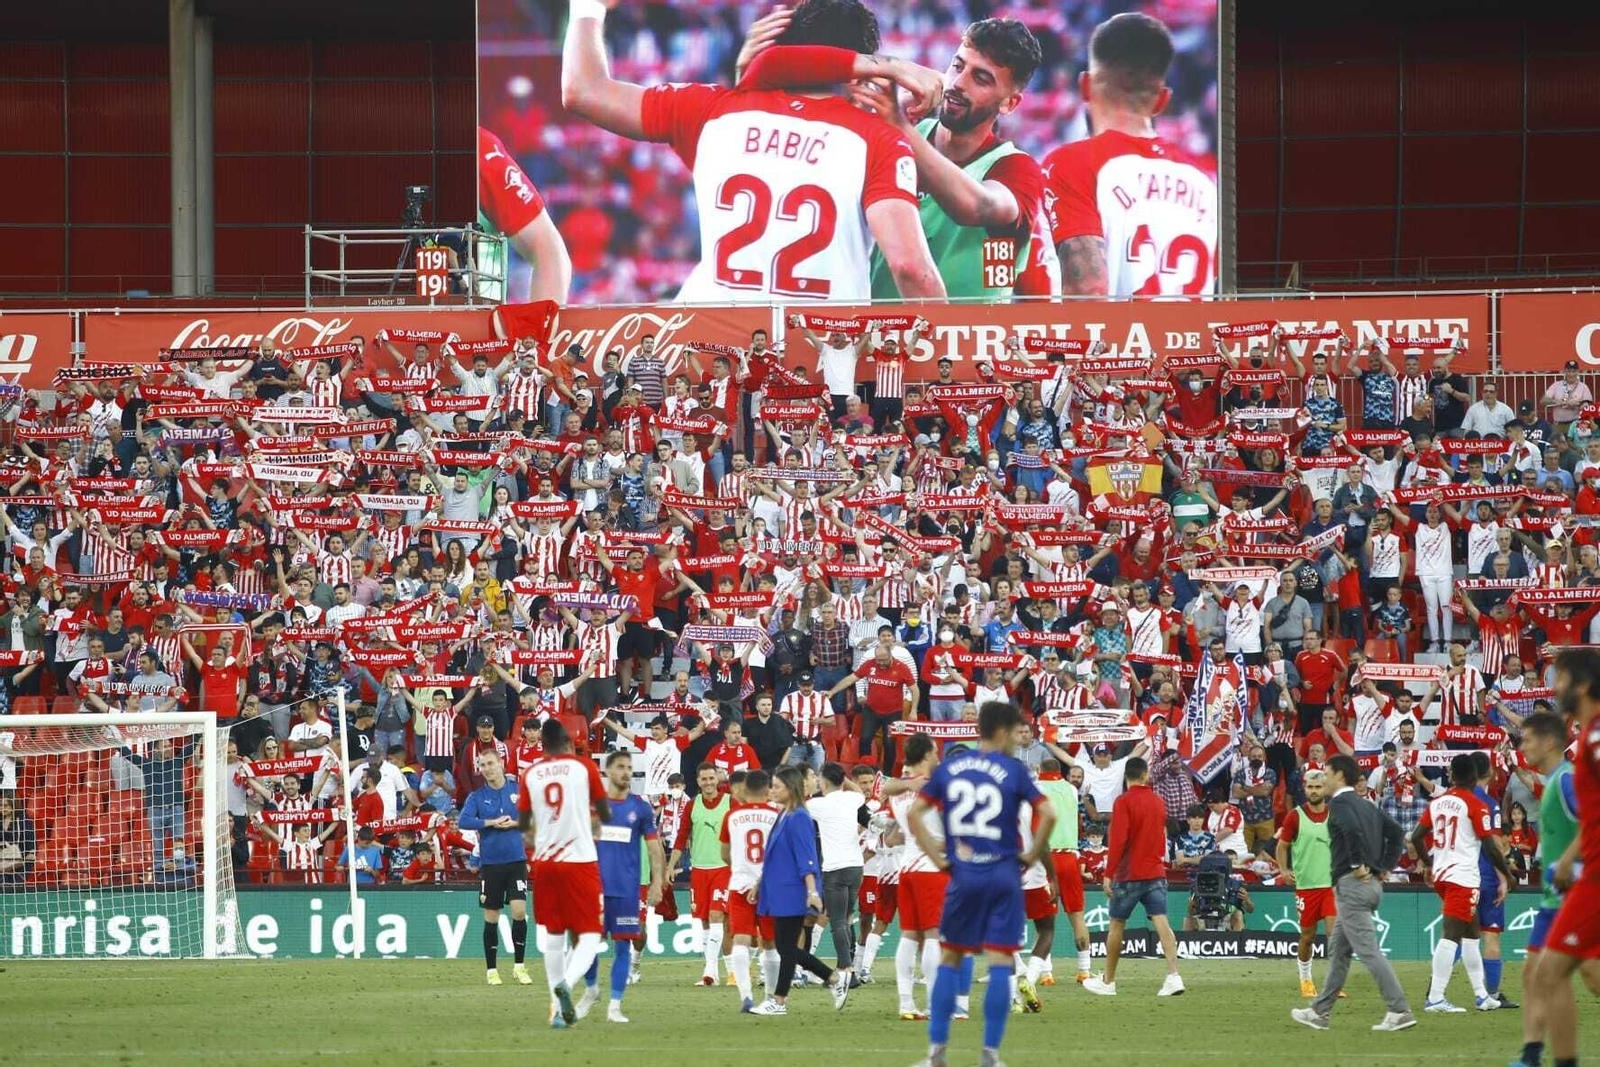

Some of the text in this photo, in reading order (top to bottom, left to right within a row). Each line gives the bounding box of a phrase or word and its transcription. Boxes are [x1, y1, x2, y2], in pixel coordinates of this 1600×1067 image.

[746, 127, 830, 164] BABIĆ
[714, 173, 838, 299] 22
[984, 241, 1010, 260] 118
[417, 252, 441, 270] 119
[985, 265, 1010, 287] 18
[418, 274, 442, 296] 19
[811, 317, 824, 325] UD
[392, 329, 405, 337] UD
[1218, 326, 1231, 334] UD
[1031, 339, 1044, 347] UD
[1166, 332, 1201, 349] DE
[999, 364, 1012, 372] UD
[377, 379, 390, 387] UD
[660, 416, 672, 424] UD
[1231, 431, 1244, 441] UD
[1351, 433, 1364, 441] UD
[82, 494, 96, 502] UD
[275, 497, 288, 505] UD
[106, 510, 119, 518] UD
[1002, 511, 1015, 519] UD
[299, 516, 312, 524] UD
[168, 533, 182, 541] UD
[609, 529, 623, 537] UD
[757, 541, 772, 551] UD
[685, 558, 699, 566] UD
[521, 582, 533, 590] UD
[1033, 585, 1047, 593] UD
[285, 627, 298, 635] UD
[401, 628, 415, 636] UD
[409, 673, 424, 682] UD
[1488, 732, 1502, 740] UD
[544, 782, 563, 824] 9
[948, 779, 1003, 841] 22
[1434, 813, 1460, 851] 31
[747, 829, 764, 863] 8
[311, 898, 410, 954] ida
[1244, 940, 1324, 956] #FANCM
